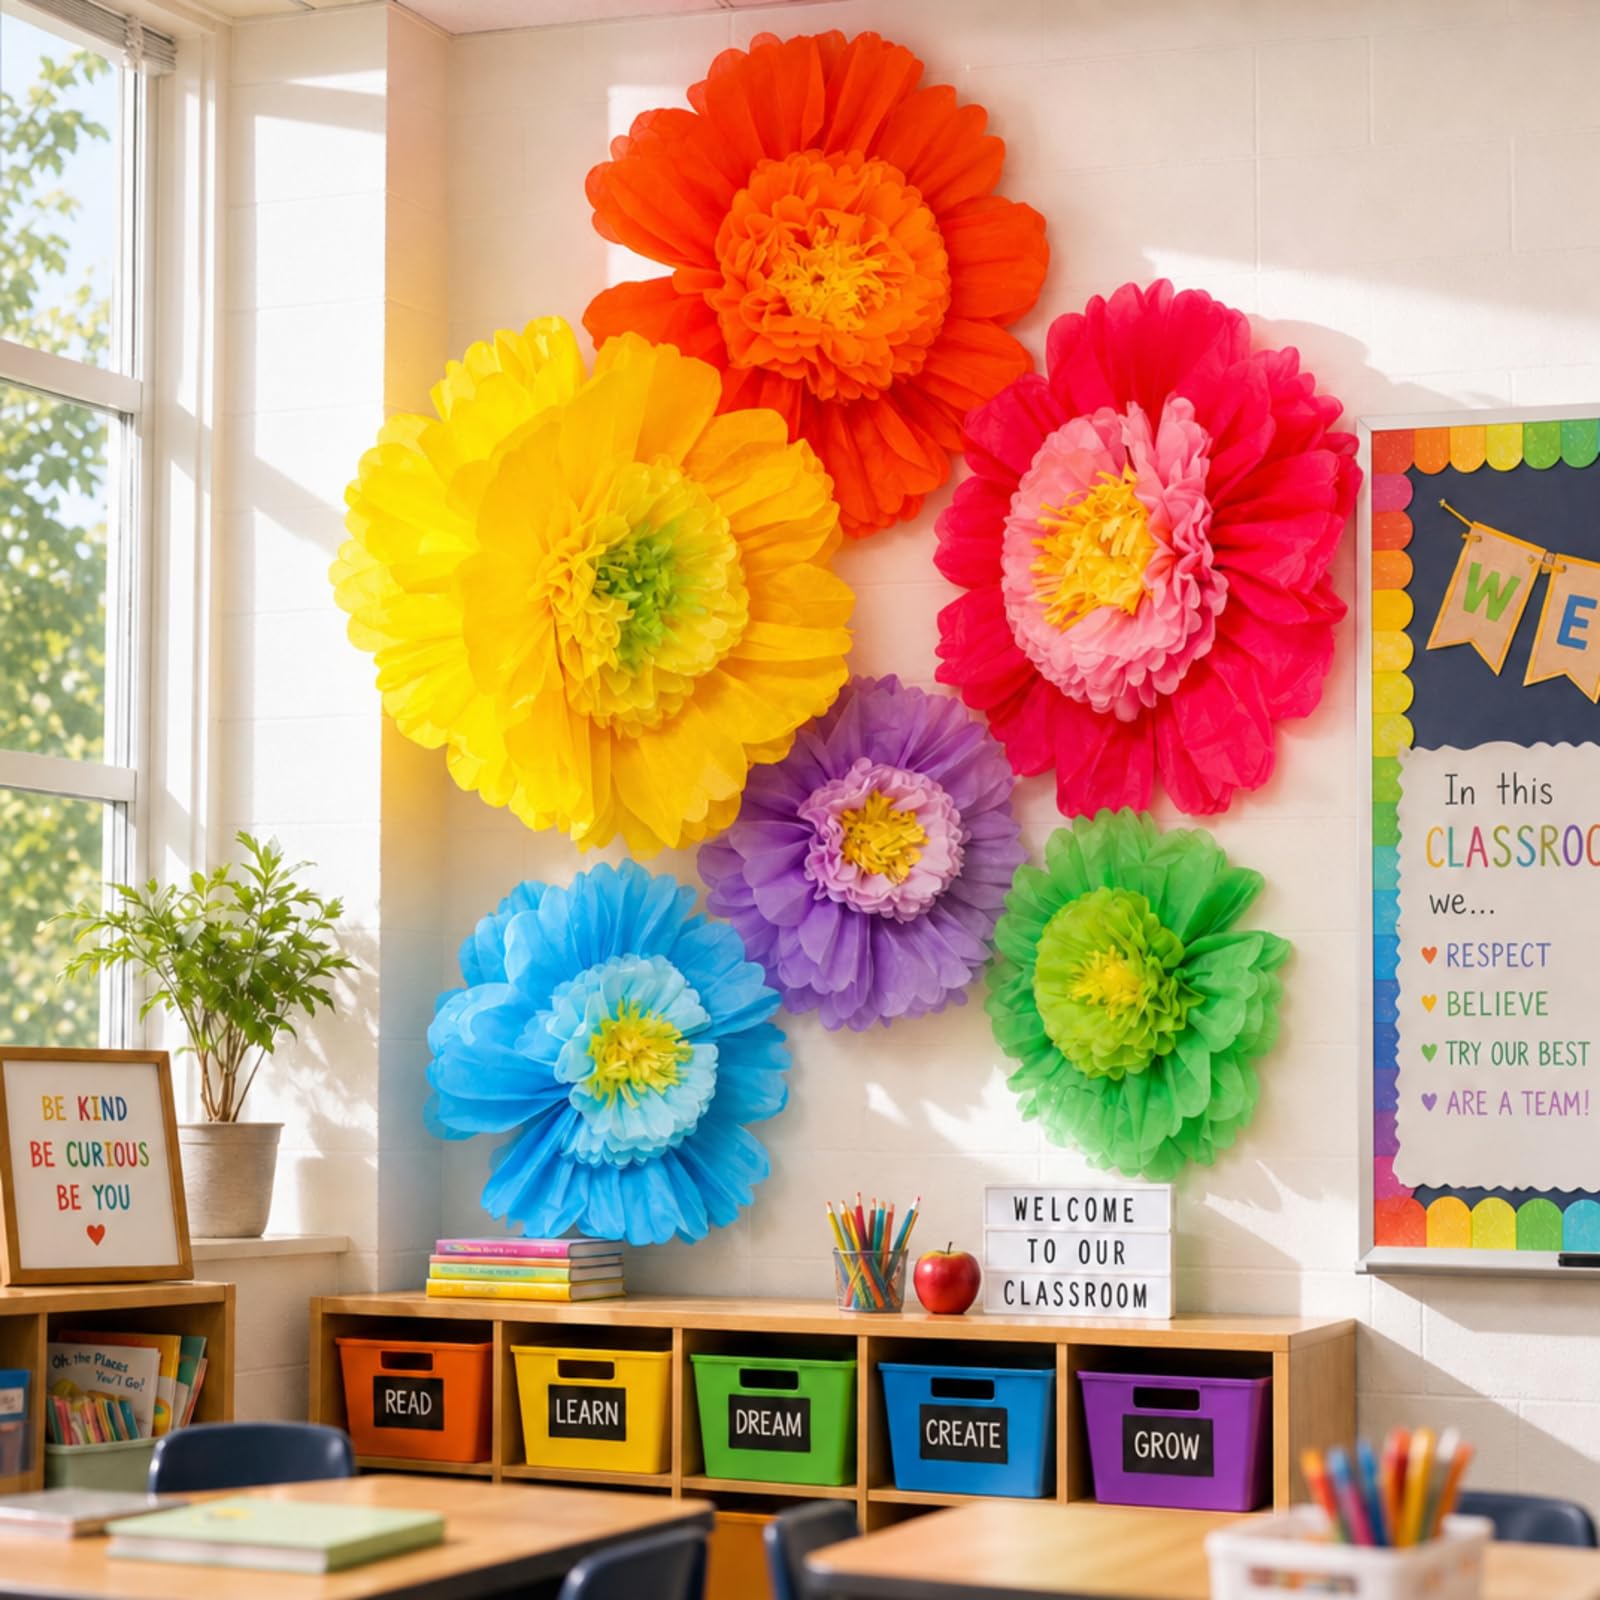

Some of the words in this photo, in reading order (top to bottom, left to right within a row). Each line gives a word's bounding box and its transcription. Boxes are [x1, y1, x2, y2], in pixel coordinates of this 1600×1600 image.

[1444, 773, 1476, 805] In
[1496, 771, 1553, 805] this
[1429, 893, 1495, 915] we...
[1446, 942, 1552, 968] RESPECT
[1446, 990, 1549, 1017] BELIEVE
[1445, 1040, 1482, 1066] TRY
[1491, 1041, 1529, 1066] OUR
[1538, 1041, 1591, 1067] BEST
[41, 1095, 67, 1121] BE
[77, 1095, 128, 1122] KIND
[1446, 1090, 1488, 1116] ARE
[1498, 1090, 1513, 1116] A
[1521, 1089, 1590, 1116] TEAM!
[29, 1141, 55, 1168] BE
[66, 1141, 150, 1168] CURIOUS
[56, 1184, 82, 1211] BE
[91, 1184, 131, 1211] YOU
[1013, 1196, 1135, 1223] WELCOME
[1027, 1238, 1056, 1264] TO
[1078, 1239, 1126, 1265] OUR
[1003, 1279, 1148, 1309] CLASSROOM
[74, 1351, 92, 1366] the
[94, 1351, 129, 1374] Places
[125, 1376, 145, 1393] Go!
[384, 1388, 433, 1416] READ
[555, 1398, 619, 1426] LEARN
[735, 1408, 803, 1438] DREAM
[926, 1418, 1001, 1449] CREATE
[1134, 1430, 1200, 1461] GROW
